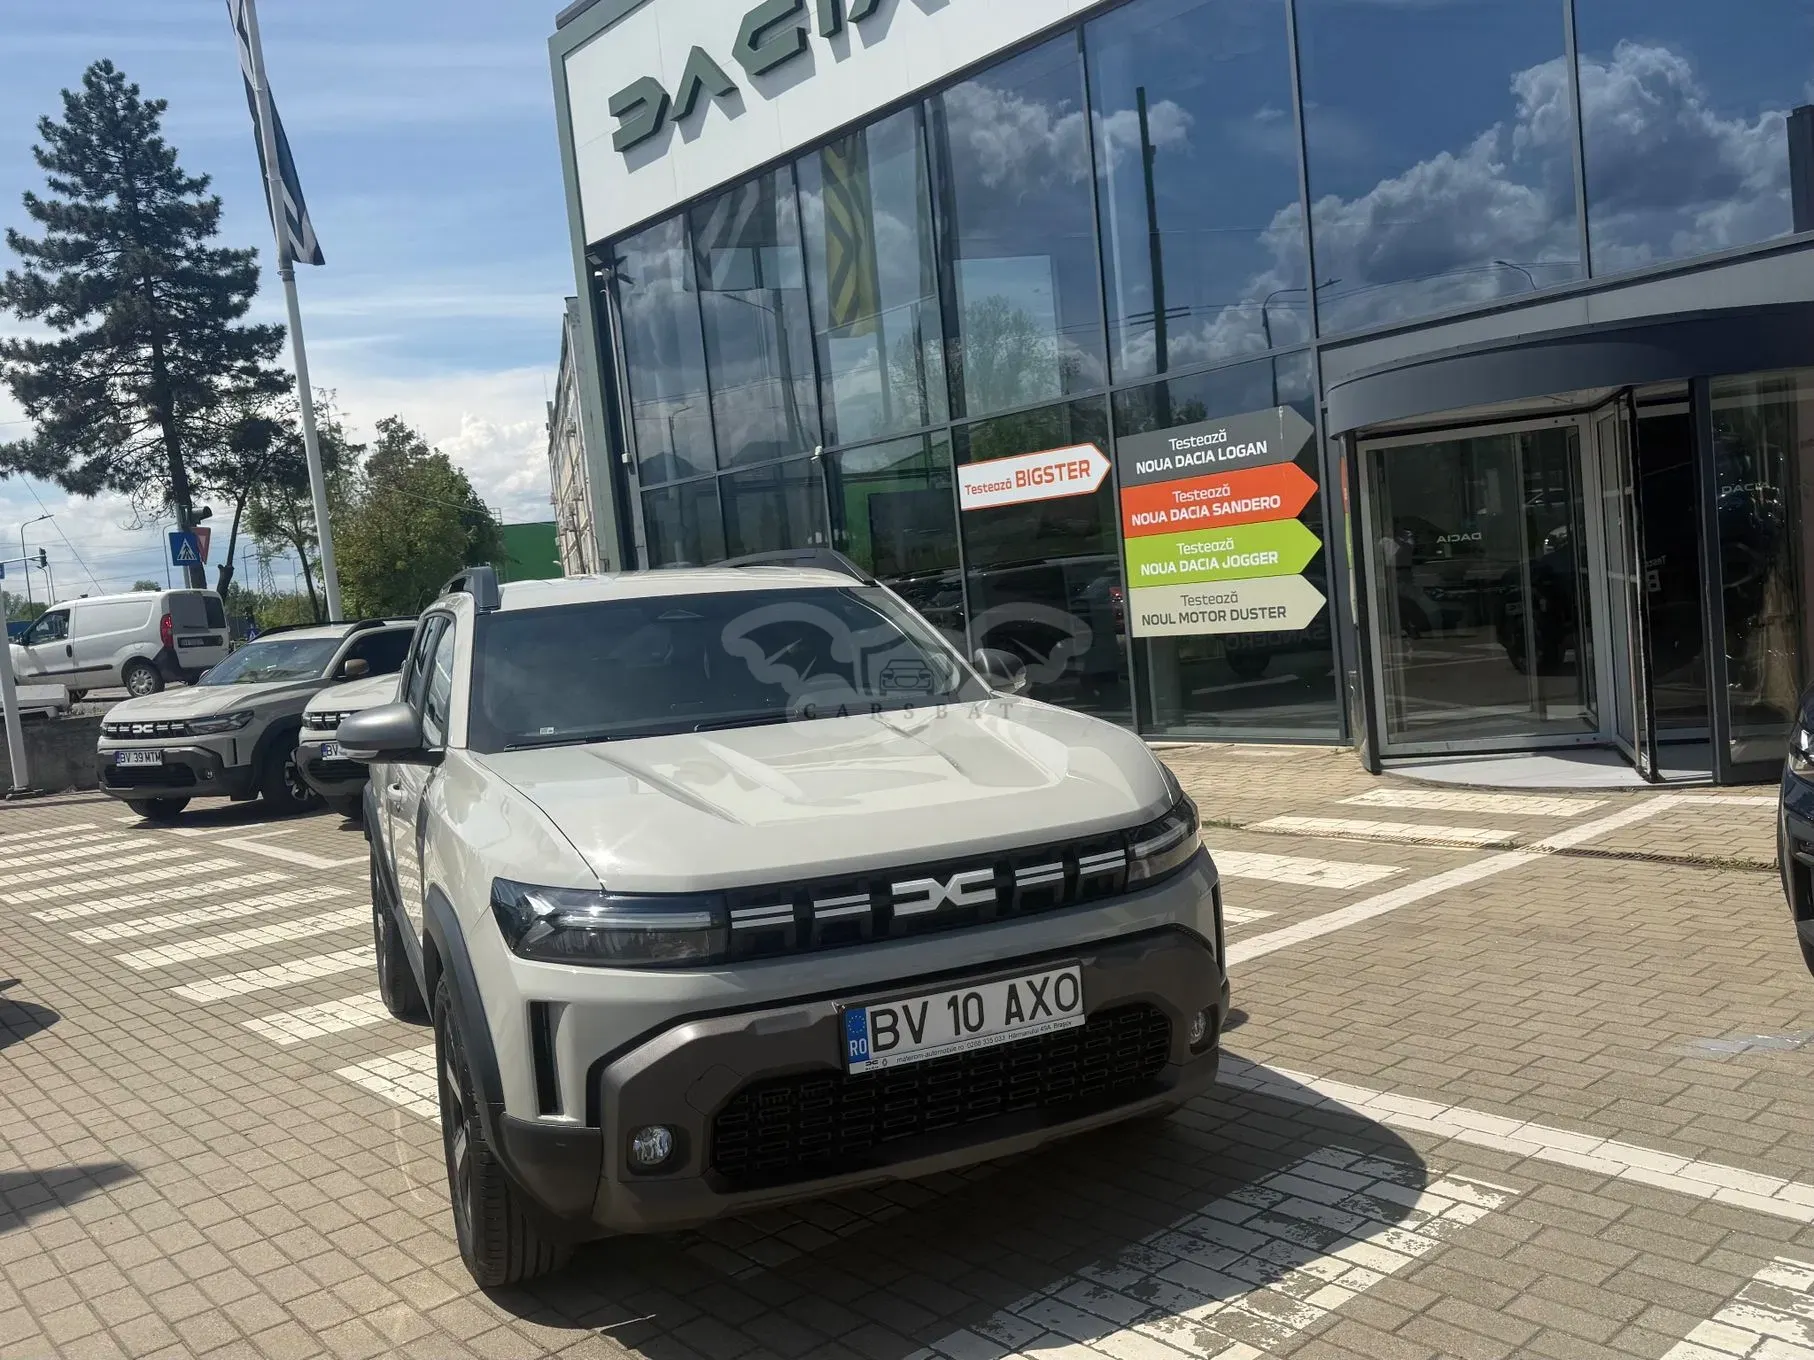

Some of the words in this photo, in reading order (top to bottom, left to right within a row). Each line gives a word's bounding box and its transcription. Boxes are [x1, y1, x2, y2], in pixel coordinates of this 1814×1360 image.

[1168, 428, 1227, 451] Testează
[1135, 459, 1173, 475] NOUA
[1175, 451, 1216, 468] DACIA
[1218, 440, 1268, 459] LOGAN
[1015, 459, 1091, 488] BIGSTER
[1172, 483, 1231, 503] Testează
[1131, 511, 1167, 526] NOUA
[1170, 504, 1210, 521] DACIA
[1212, 495, 1281, 516] SANDERO
[1176, 537, 1235, 556] Testează
[1140, 561, 1177, 576] NOUA
[1179, 556, 1219, 572] DACIA
[1222, 551, 1279, 568] JOGGER
[1180, 590, 1239, 607] Testează
[1141, 613, 1176, 626] NOUL
[1178, 609, 1227, 625] MOTOR
[1229, 605, 1287, 622] DUSTER
[120, 752, 131, 763] BV
[870, 1000, 929, 1053] BV
[947, 991, 985, 1036] 10
[1004, 972, 1080, 1025] AXO
[850, 1038, 868, 1057] RO
